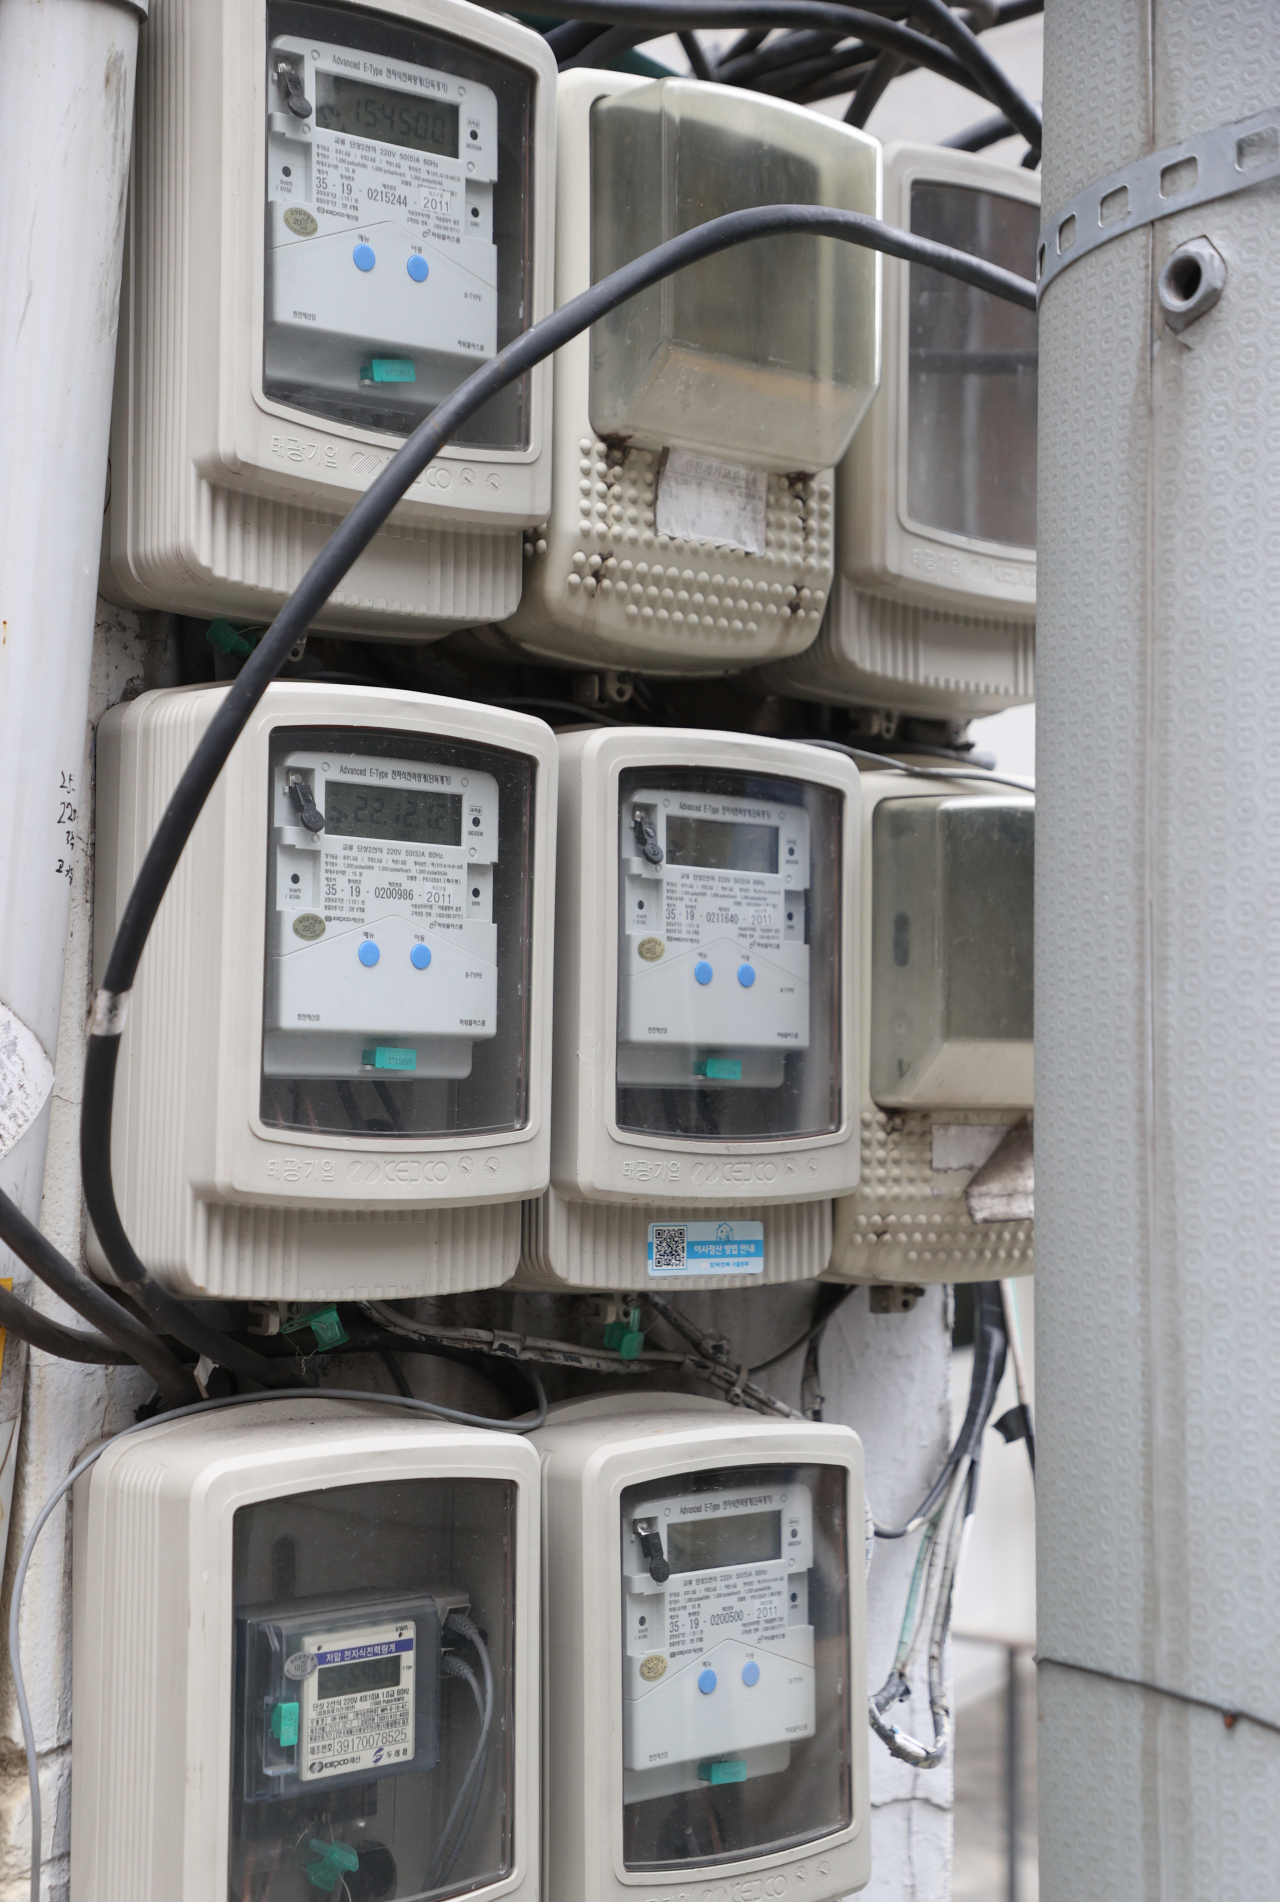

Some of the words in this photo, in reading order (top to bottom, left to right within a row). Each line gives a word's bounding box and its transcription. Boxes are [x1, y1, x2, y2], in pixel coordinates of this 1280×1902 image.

[332, 54, 361, 71] Advanced
[363, 62, 383, 77] E-Type
[334, 137, 346, 146] 교류
[380, 148, 396, 158] 220V
[399, 152, 420, 164] 50(5)A
[423, 158, 439, 169] 60Hz
[316, 176, 328, 190] 35
[341, 182, 353, 196] 19
[367, 187, 407, 207] 0215244
[423, 196, 449, 213] 2011
[270, 435, 339, 468] 태광기업
[339, 765, 366, 777] Advanced
[369, 768, 389, 779] E-Type
[391, 769, 451, 786] 전자식전력량계(단독계기)
[342, 844, 354, 852] 교류
[357, 844, 383, 854] 단상2선식
[386, 848, 402, 856] 220V
[405, 849, 425, 858] 50(5)A
[325, 883, 337, 896] 35
[350, 885, 361, 898] 19
[374, 886, 414, 900] 0200986
[426, 891, 451, 904] 2011
[666, 908, 676, 920] 35
[686, 910, 695, 920] 19
[706, 912, 739, 924] 0211640
[751, 914, 772, 925] 2011
[363, 931, 374, 939] 메뉴
[414, 934, 425, 942] 이동
[267, 1157, 335, 1181] 태광기업
[384, 1160, 450, 1188] KEPCO
[623, 1160, 681, 1182] 태광기업
[722, 1161, 778, 1187] KEPCO
[694, 1244, 723, 1255] 이사정산
[724, 1244, 738, 1254] 방법
[740, 1243, 755, 1253] 안내
[704, 1503, 721, 1512] E-Type
[669, 1620, 679, 1633] 35
[690, 1617, 699, 1630] 19
[710, 1610, 744, 1626] 0200500
[756, 1606, 777, 1619] 2011
[326, 1652, 341, 1662] 저압
[343, 1643, 396, 1660] 전자식전력량계
[312, 1703, 325, 1712] 단상
[326, 1700, 342, 1709] 2선식
[343, 1697, 358, 1706] 220V
[381, 1689, 395, 1699] 1.0급
[396, 1688, 409, 1697] 60Hz
[309, 1743, 333, 1756] 제조번호
[336, 1728, 407, 1754] 39170078525
